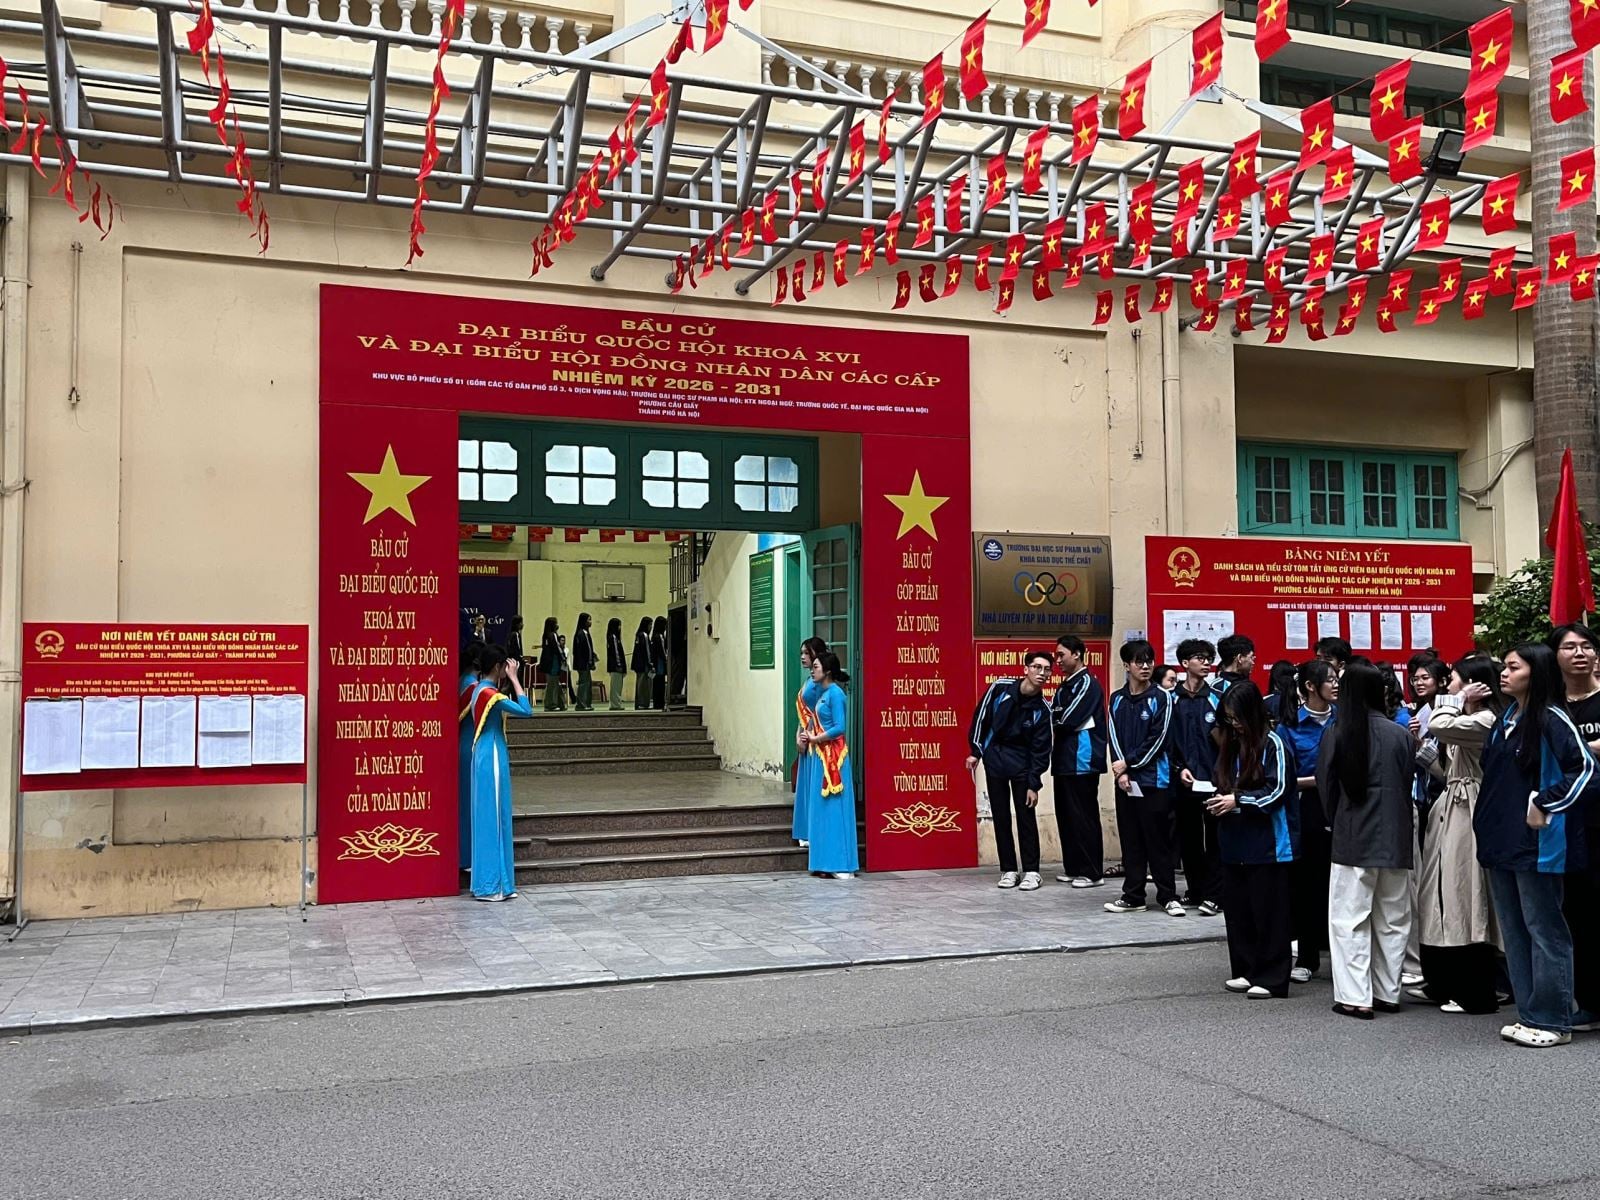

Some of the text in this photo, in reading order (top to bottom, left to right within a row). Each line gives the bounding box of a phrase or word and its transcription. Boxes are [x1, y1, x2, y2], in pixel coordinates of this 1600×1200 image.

[622, 318, 716, 336] BẦU CỬ
[458, 323, 860, 364] ĐẠI BIỂU QUỐC HỘI KHOÁ XVI
[357, 335, 940, 386] VÀ ĐẠI BIỂU HỘI ĐỒNG NHÂN DÂN CÁC CẤP
[552, 370, 781, 396] NHIỆM KỲ 2026 2031
[371, 529, 408, 558] BẦU CỬ
[1285, 547, 1390, 562] BẢNG NIÊM YẾT
[903, 544, 932, 569] BẦU CỬ
[1235, 562, 1254, 571] SÁCH
[1255, 563, 1264, 571] VÀ
[1266, 562, 1281, 571] TIỂU
[1283, 563, 1292, 572] SỬ
[1294, 563, 1308, 572] TÓM
[1310, 563, 1321, 572] TẮT
[1323, 564, 1337, 573] ỨNG
[1339, 564, 1348, 573] CỬ
[1350, 565, 1364, 574] VIÊN
[1366, 566, 1377, 574] ĐẠI
[1379, 565, 1394, 574] BIỂU
[1395, 566, 1412, 575] QUỐC
[1414, 566, 1425, 576] HỘI
[1426, 567, 1444, 575] KHÓA
[340, 562, 439, 598] ĐẠI BIỂU QUỐC HỘI
[897, 578, 914, 600] GÓP
[1230, 574, 1239, 582] VÀ
[1241, 574, 1253, 583] ĐẠI
[1254, 573, 1270, 582] BIỂU
[1272, 574, 1284, 583] HỘI
[1285, 574, 1304, 583] ĐỒNG
[1306, 575, 1325, 583] NHÂN
[1326, 575, 1340, 583] DÂN
[1342, 576, 1356, 584] CÁC
[1357, 576, 1370, 584] CẤP
[1274, 585, 1402, 596] PHƯỜNG CẦU GIẤY THÀNH PHỐ HÀ NỘI
[364, 605, 415, 630] KHOÁ XVI
[896, 611, 939, 636] XÂY DỰNG
[101, 630, 276, 641] NƠI NIÊM YẾT DANH SÁCH CỬ TRI
[330, 635, 448, 670] VÀ ĐẠI BIỂU HỘI ĐỒNG
[897, 642, 939, 664] NHÀ NƯỚC
[981, 649, 1102, 665] NƠI NIÊM TRI
[339, 674, 440, 702] NHÂN DÂN CÁC CẤP
[892, 670, 945, 696] PHÁP QUYỀN
[336, 714, 442, 743] NHIỆM KỲ 2026 2031
[881, 704, 957, 731] XÃ HỘI CHỦ NGHĨA
[900, 738, 940, 762] VIỆT NAM
[355, 750, 423, 779] LÀ NGÀY HỘI
[894, 770, 917, 792] VỮNG
[348, 784, 369, 813] CỦA
[371, 786, 400, 812] TOÀN
